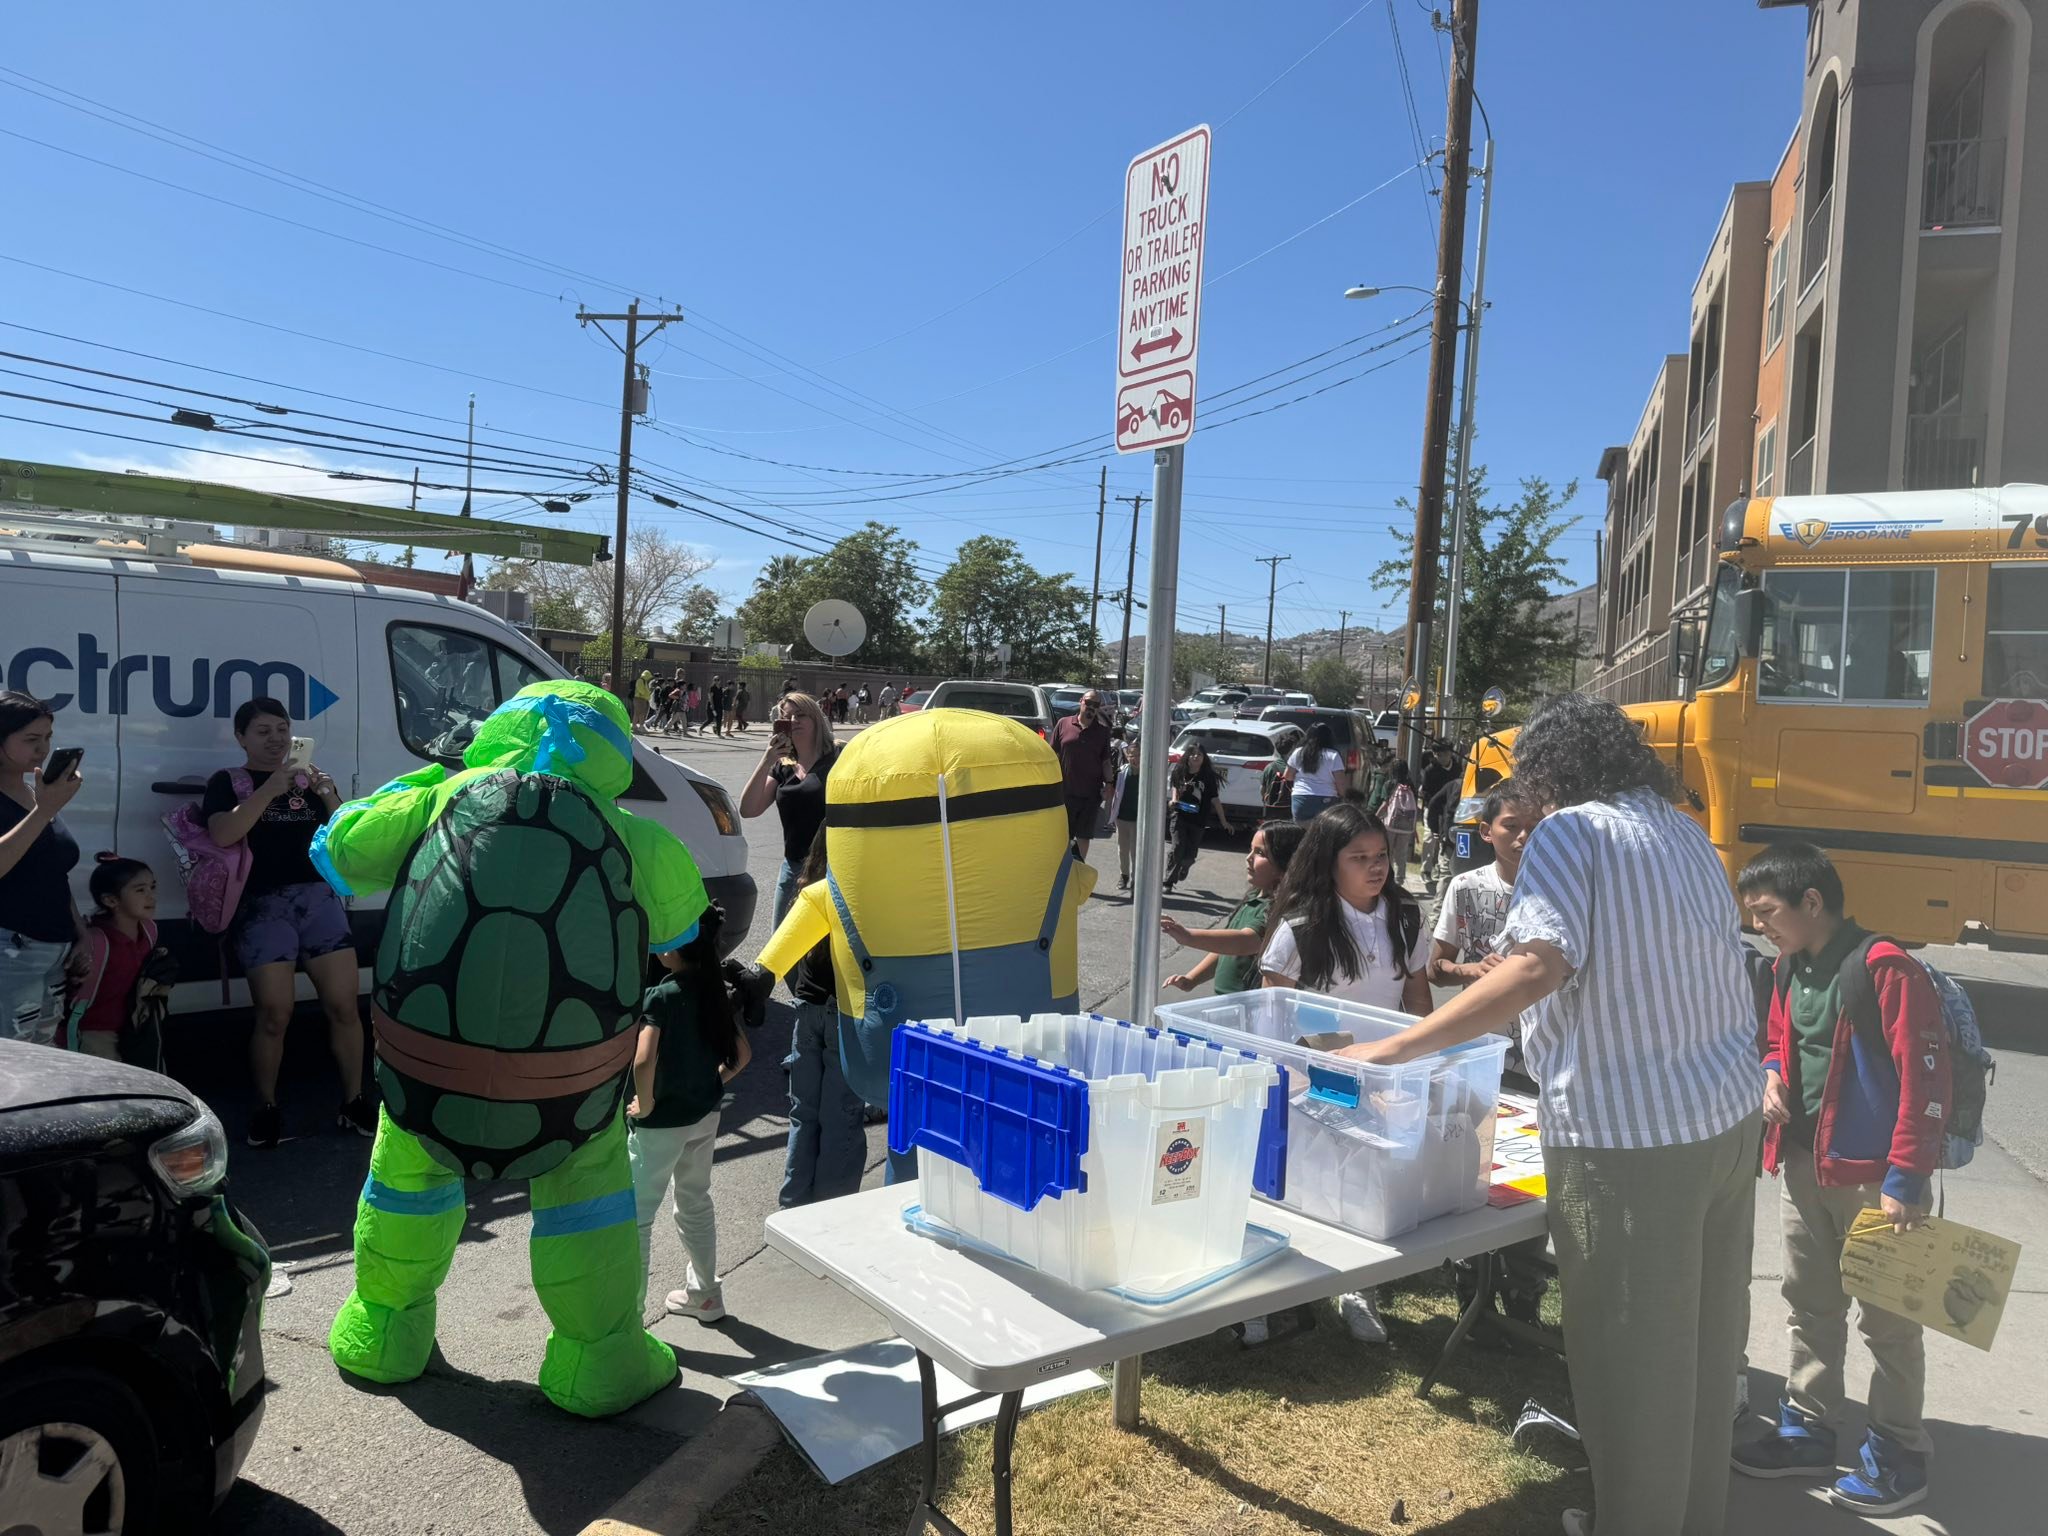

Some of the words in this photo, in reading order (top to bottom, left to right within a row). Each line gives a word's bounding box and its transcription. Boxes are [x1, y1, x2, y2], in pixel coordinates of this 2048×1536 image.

[1151, 152, 1180, 202] NO
[1138, 192, 1188, 239] TRUCK
[1126, 243, 1144, 276] OR
[1147, 221, 1199, 269] TRAILER
[1132, 259, 1191, 302] PARKING
[1129, 291, 1190, 334] ANYTIME
[1832, 529, 1913, 541] PROPANE
[0, 633, 305, 720] ctrum
[1978, 727, 2048, 760] STOP
